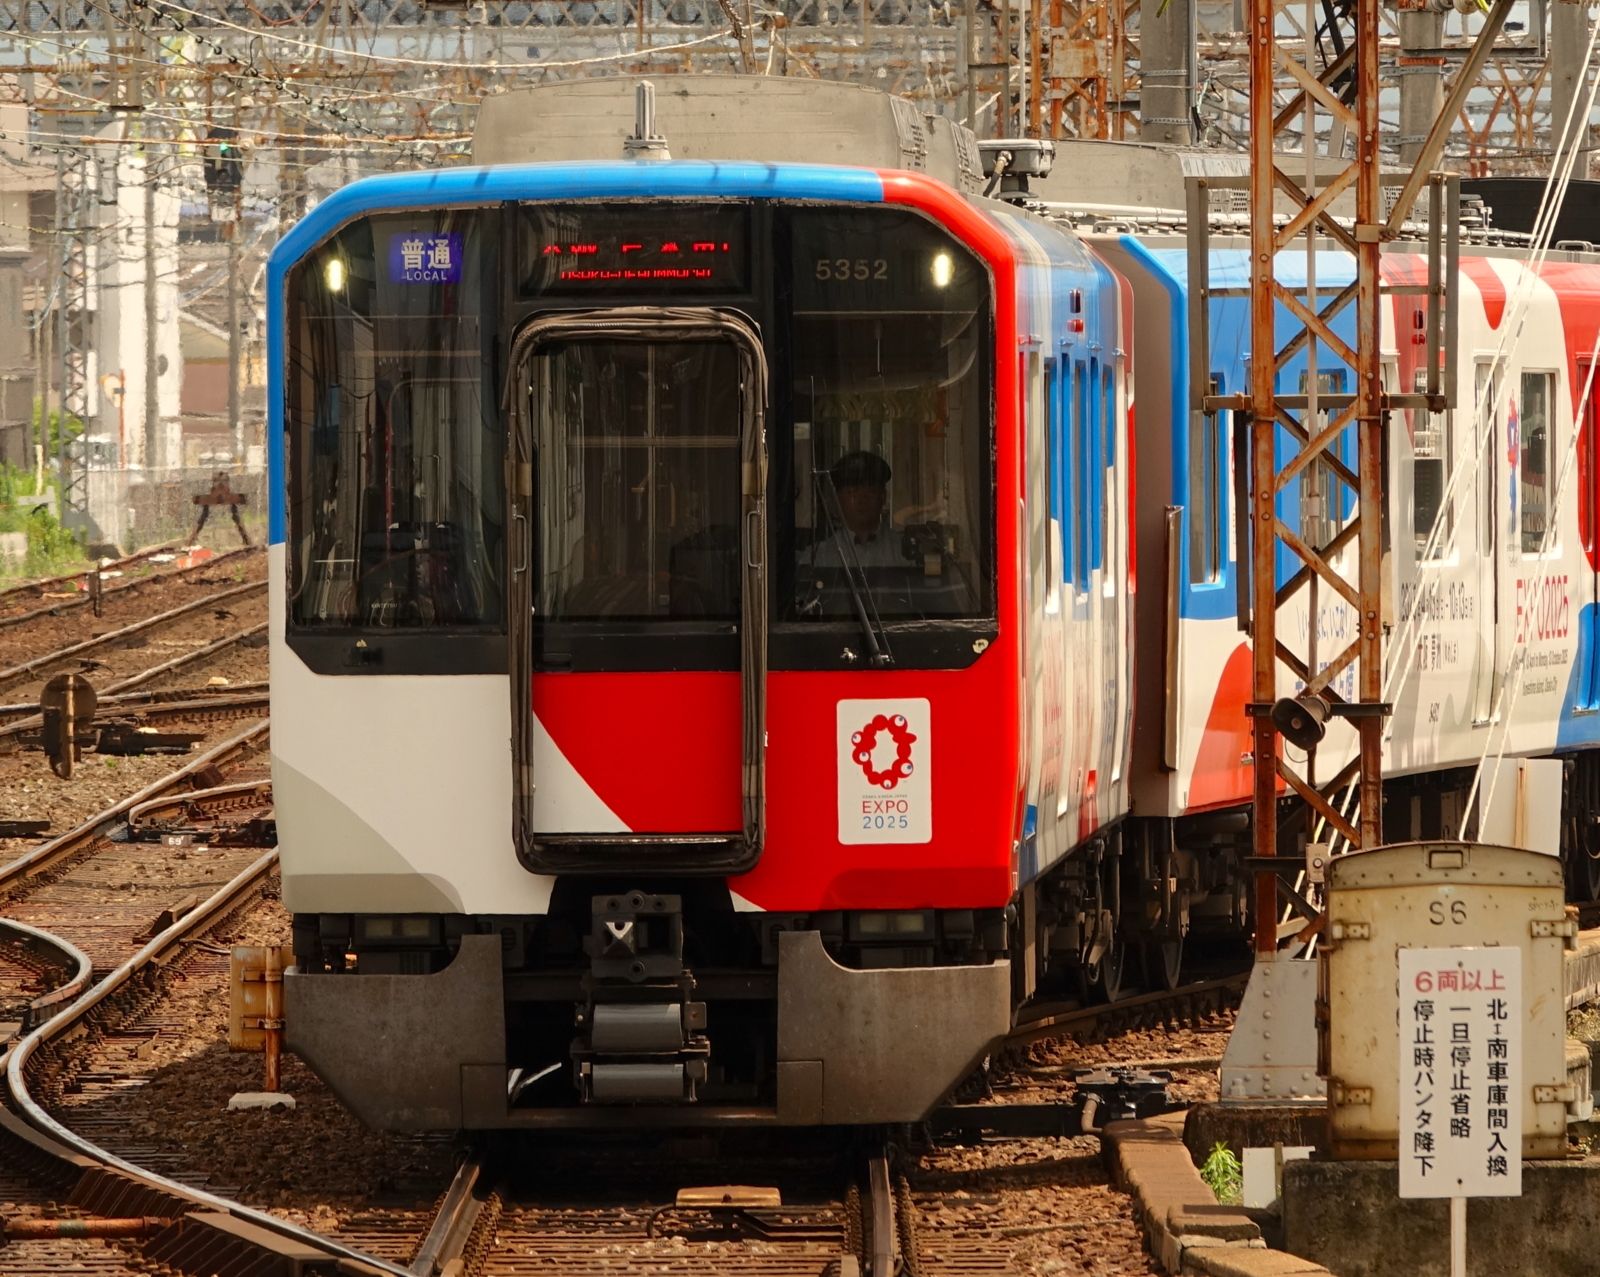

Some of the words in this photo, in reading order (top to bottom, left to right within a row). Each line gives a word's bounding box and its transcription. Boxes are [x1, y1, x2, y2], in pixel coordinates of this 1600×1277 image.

[401, 238, 452, 270] 普通
[406, 270, 448, 281] LOCAL
[815, 258, 888, 280] 5352
[862, 799, 909, 814] EXPO
[863, 815, 909, 829] 2025
[1428, 900, 1468, 926] S6
[1414, 968, 1506, 993] 6両以上
[1449, 1005, 1472, 1139] 一旦停止省略
[1413, 999, 1436, 1177] 停止時パンタ降下
